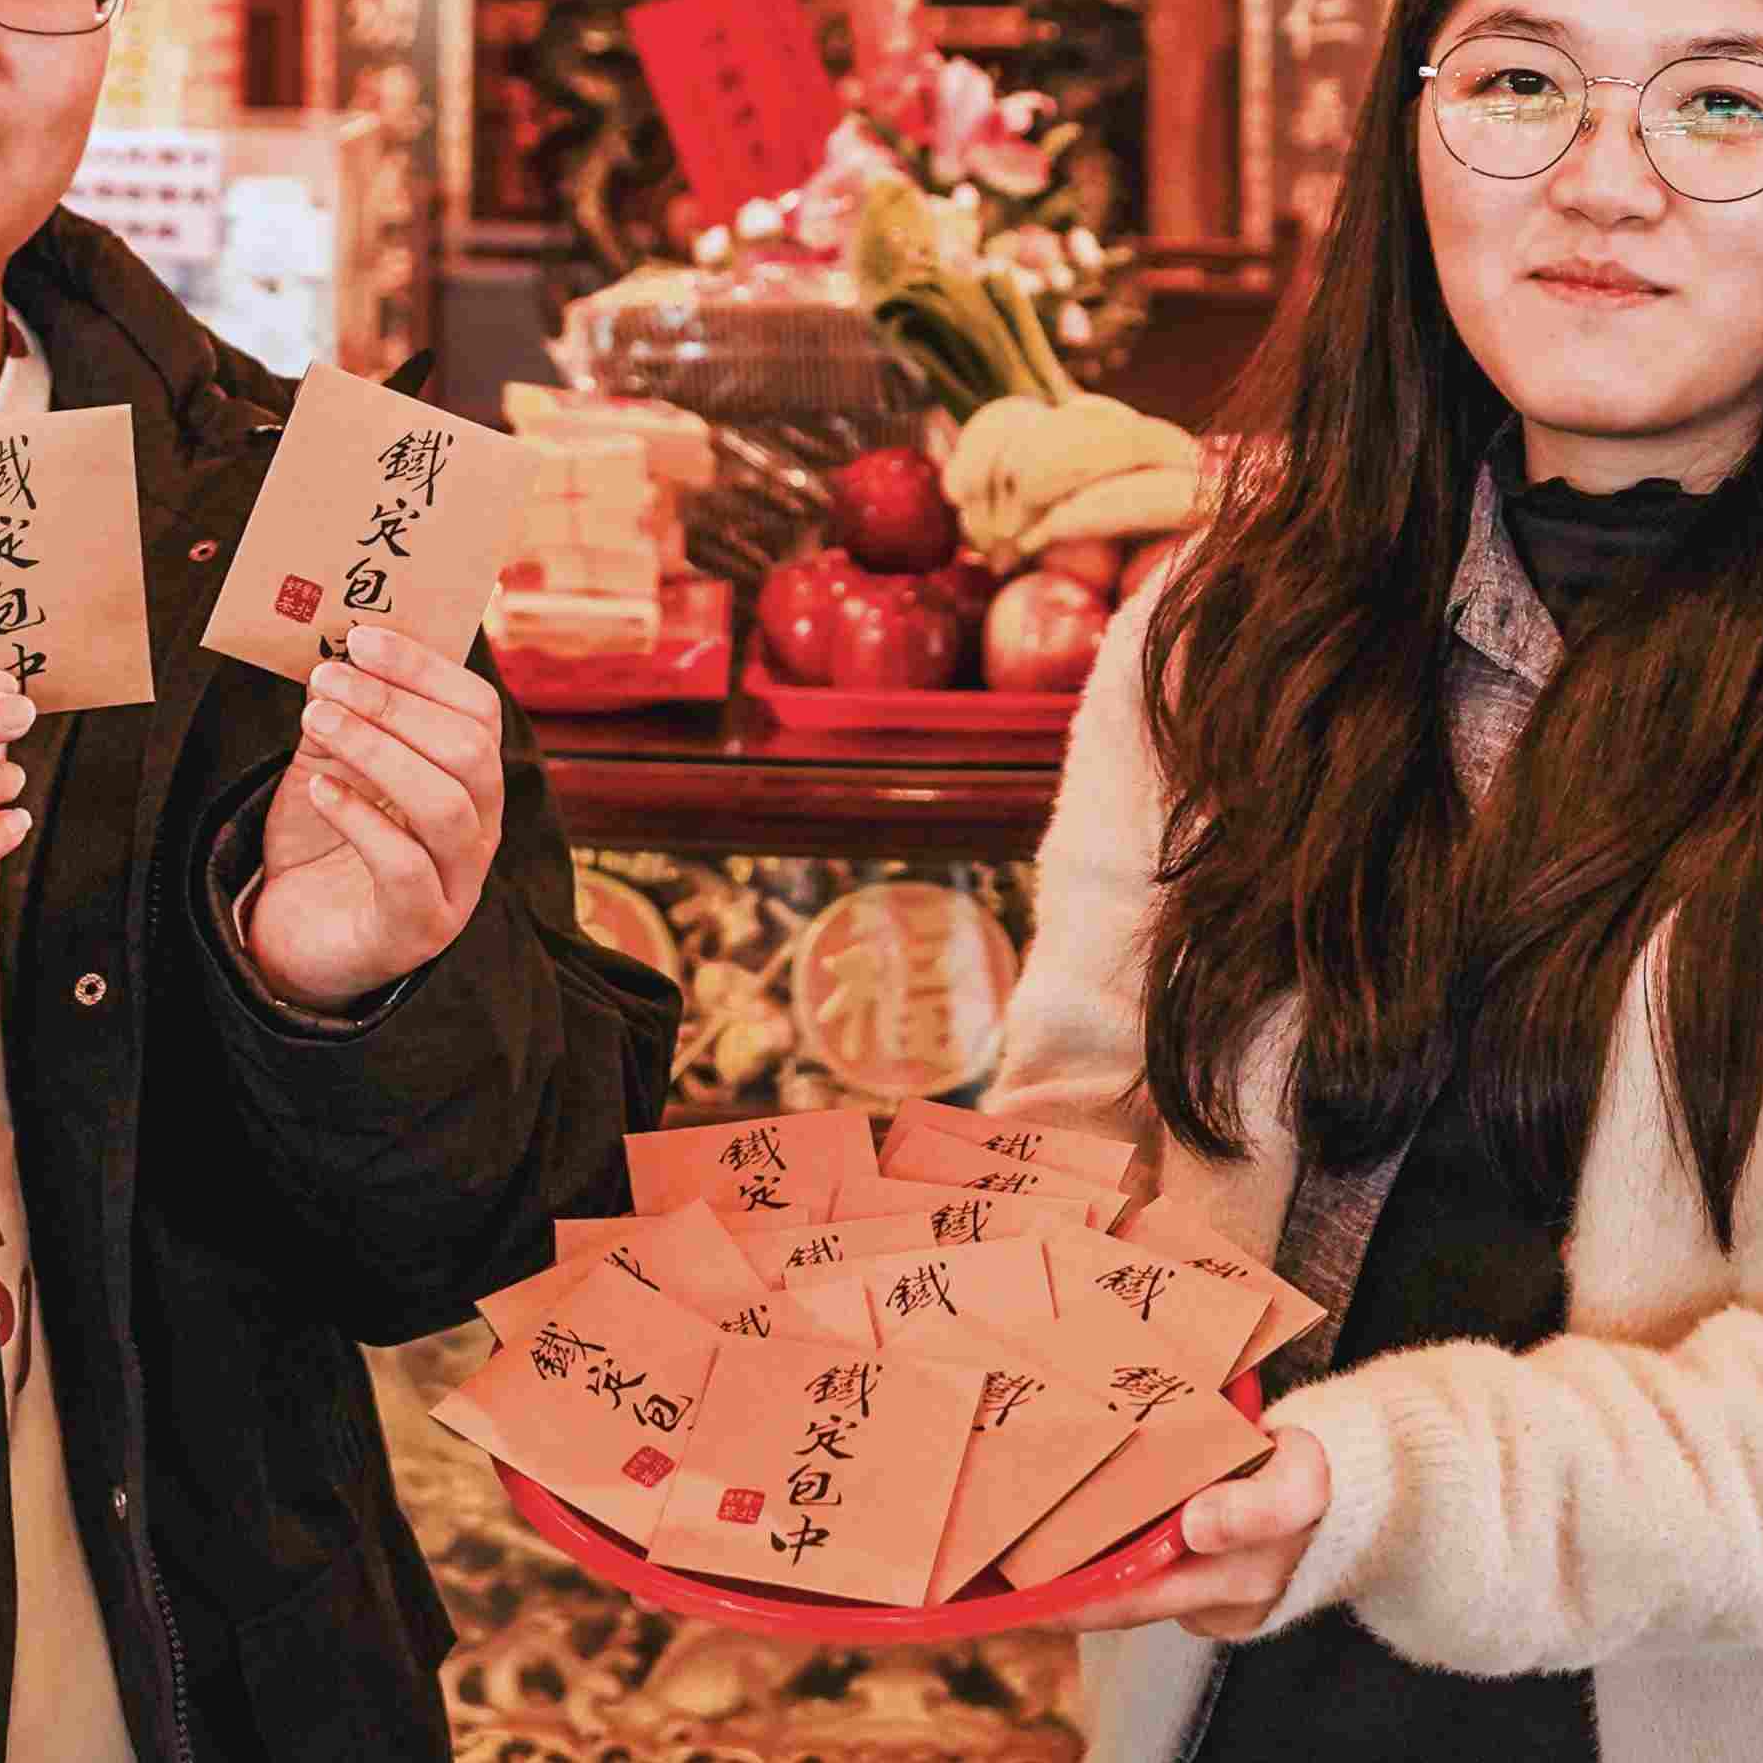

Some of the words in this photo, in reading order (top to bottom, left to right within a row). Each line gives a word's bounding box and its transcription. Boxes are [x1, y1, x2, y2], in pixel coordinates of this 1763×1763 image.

[719, 1126, 791, 1212] 鐵定
[885, 1262, 957, 1316] 鐵
[1095, 1264, 1175, 1322] 鐵
[530, 1322, 694, 1433] 鐵定包
[972, 1371, 1046, 1432] 鐵
[1108, 1367, 1195, 1423] 鐵
[770, 1362, 882, 1567] 鐵定包中
